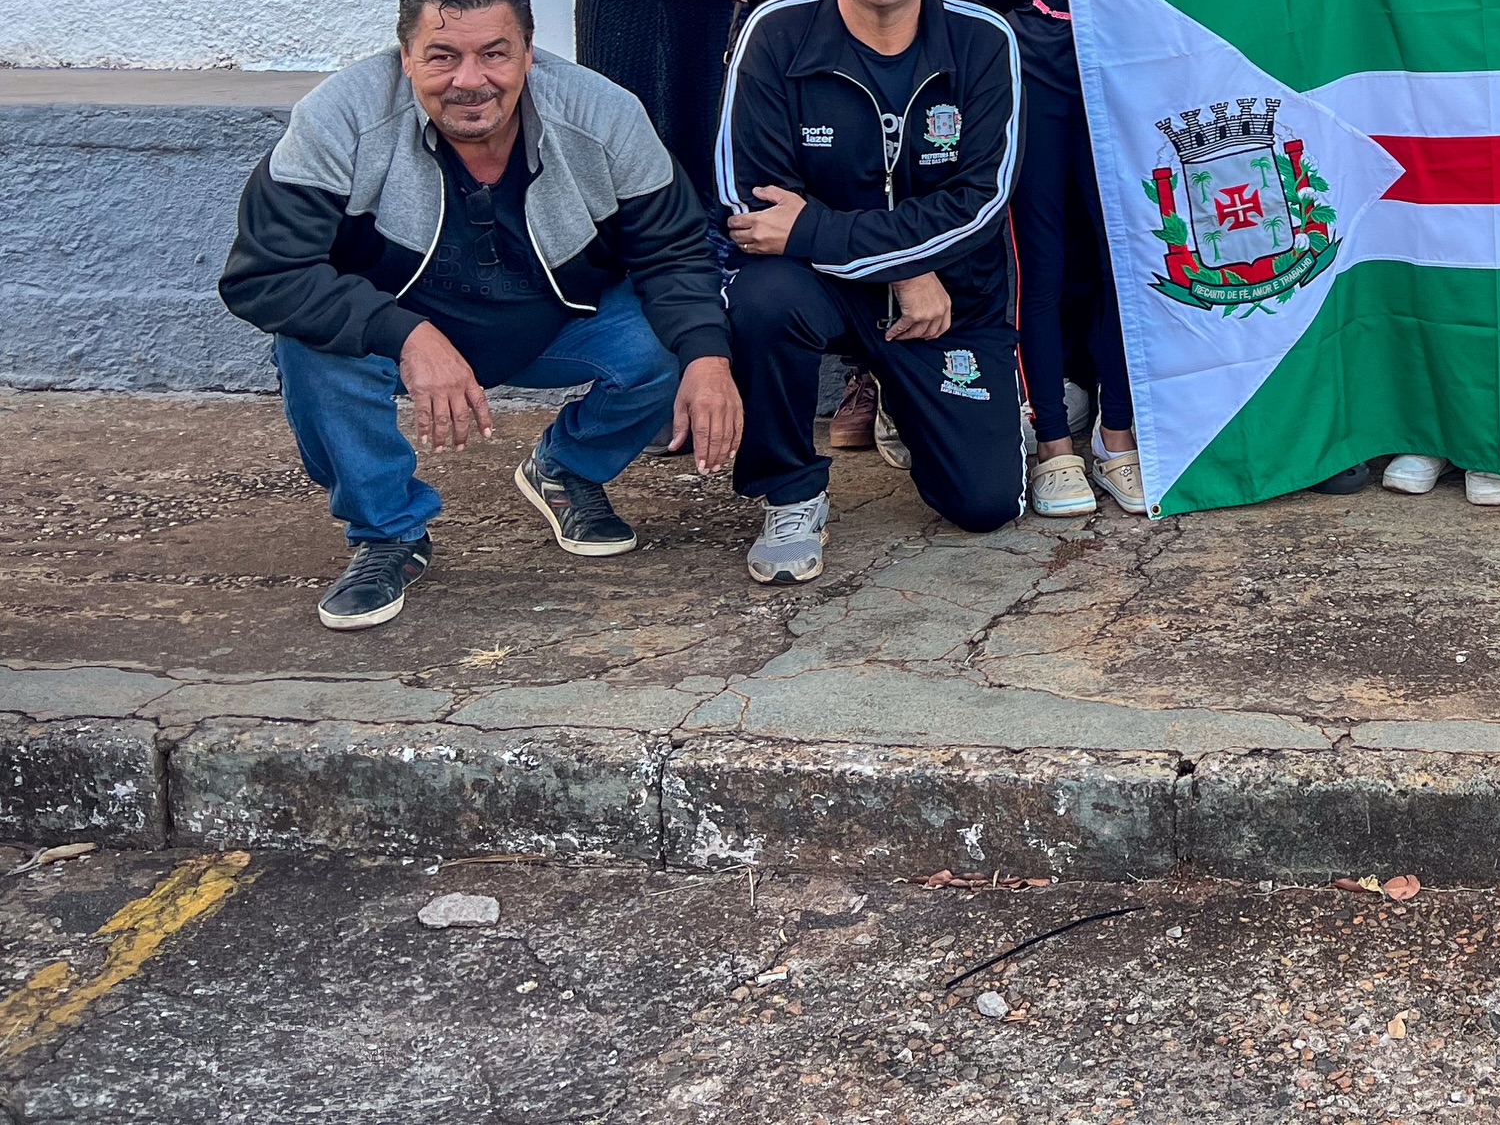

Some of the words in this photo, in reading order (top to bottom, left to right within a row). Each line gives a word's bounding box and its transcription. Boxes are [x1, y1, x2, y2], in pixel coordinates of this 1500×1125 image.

[423, 278, 491, 295] HUGO
[1194, 284, 1226, 299] RECANTO
[1227, 291, 1237, 299] DE
[1252, 284, 1273, 298] AMOR
[1280, 257, 1313, 286] TRABALHO
